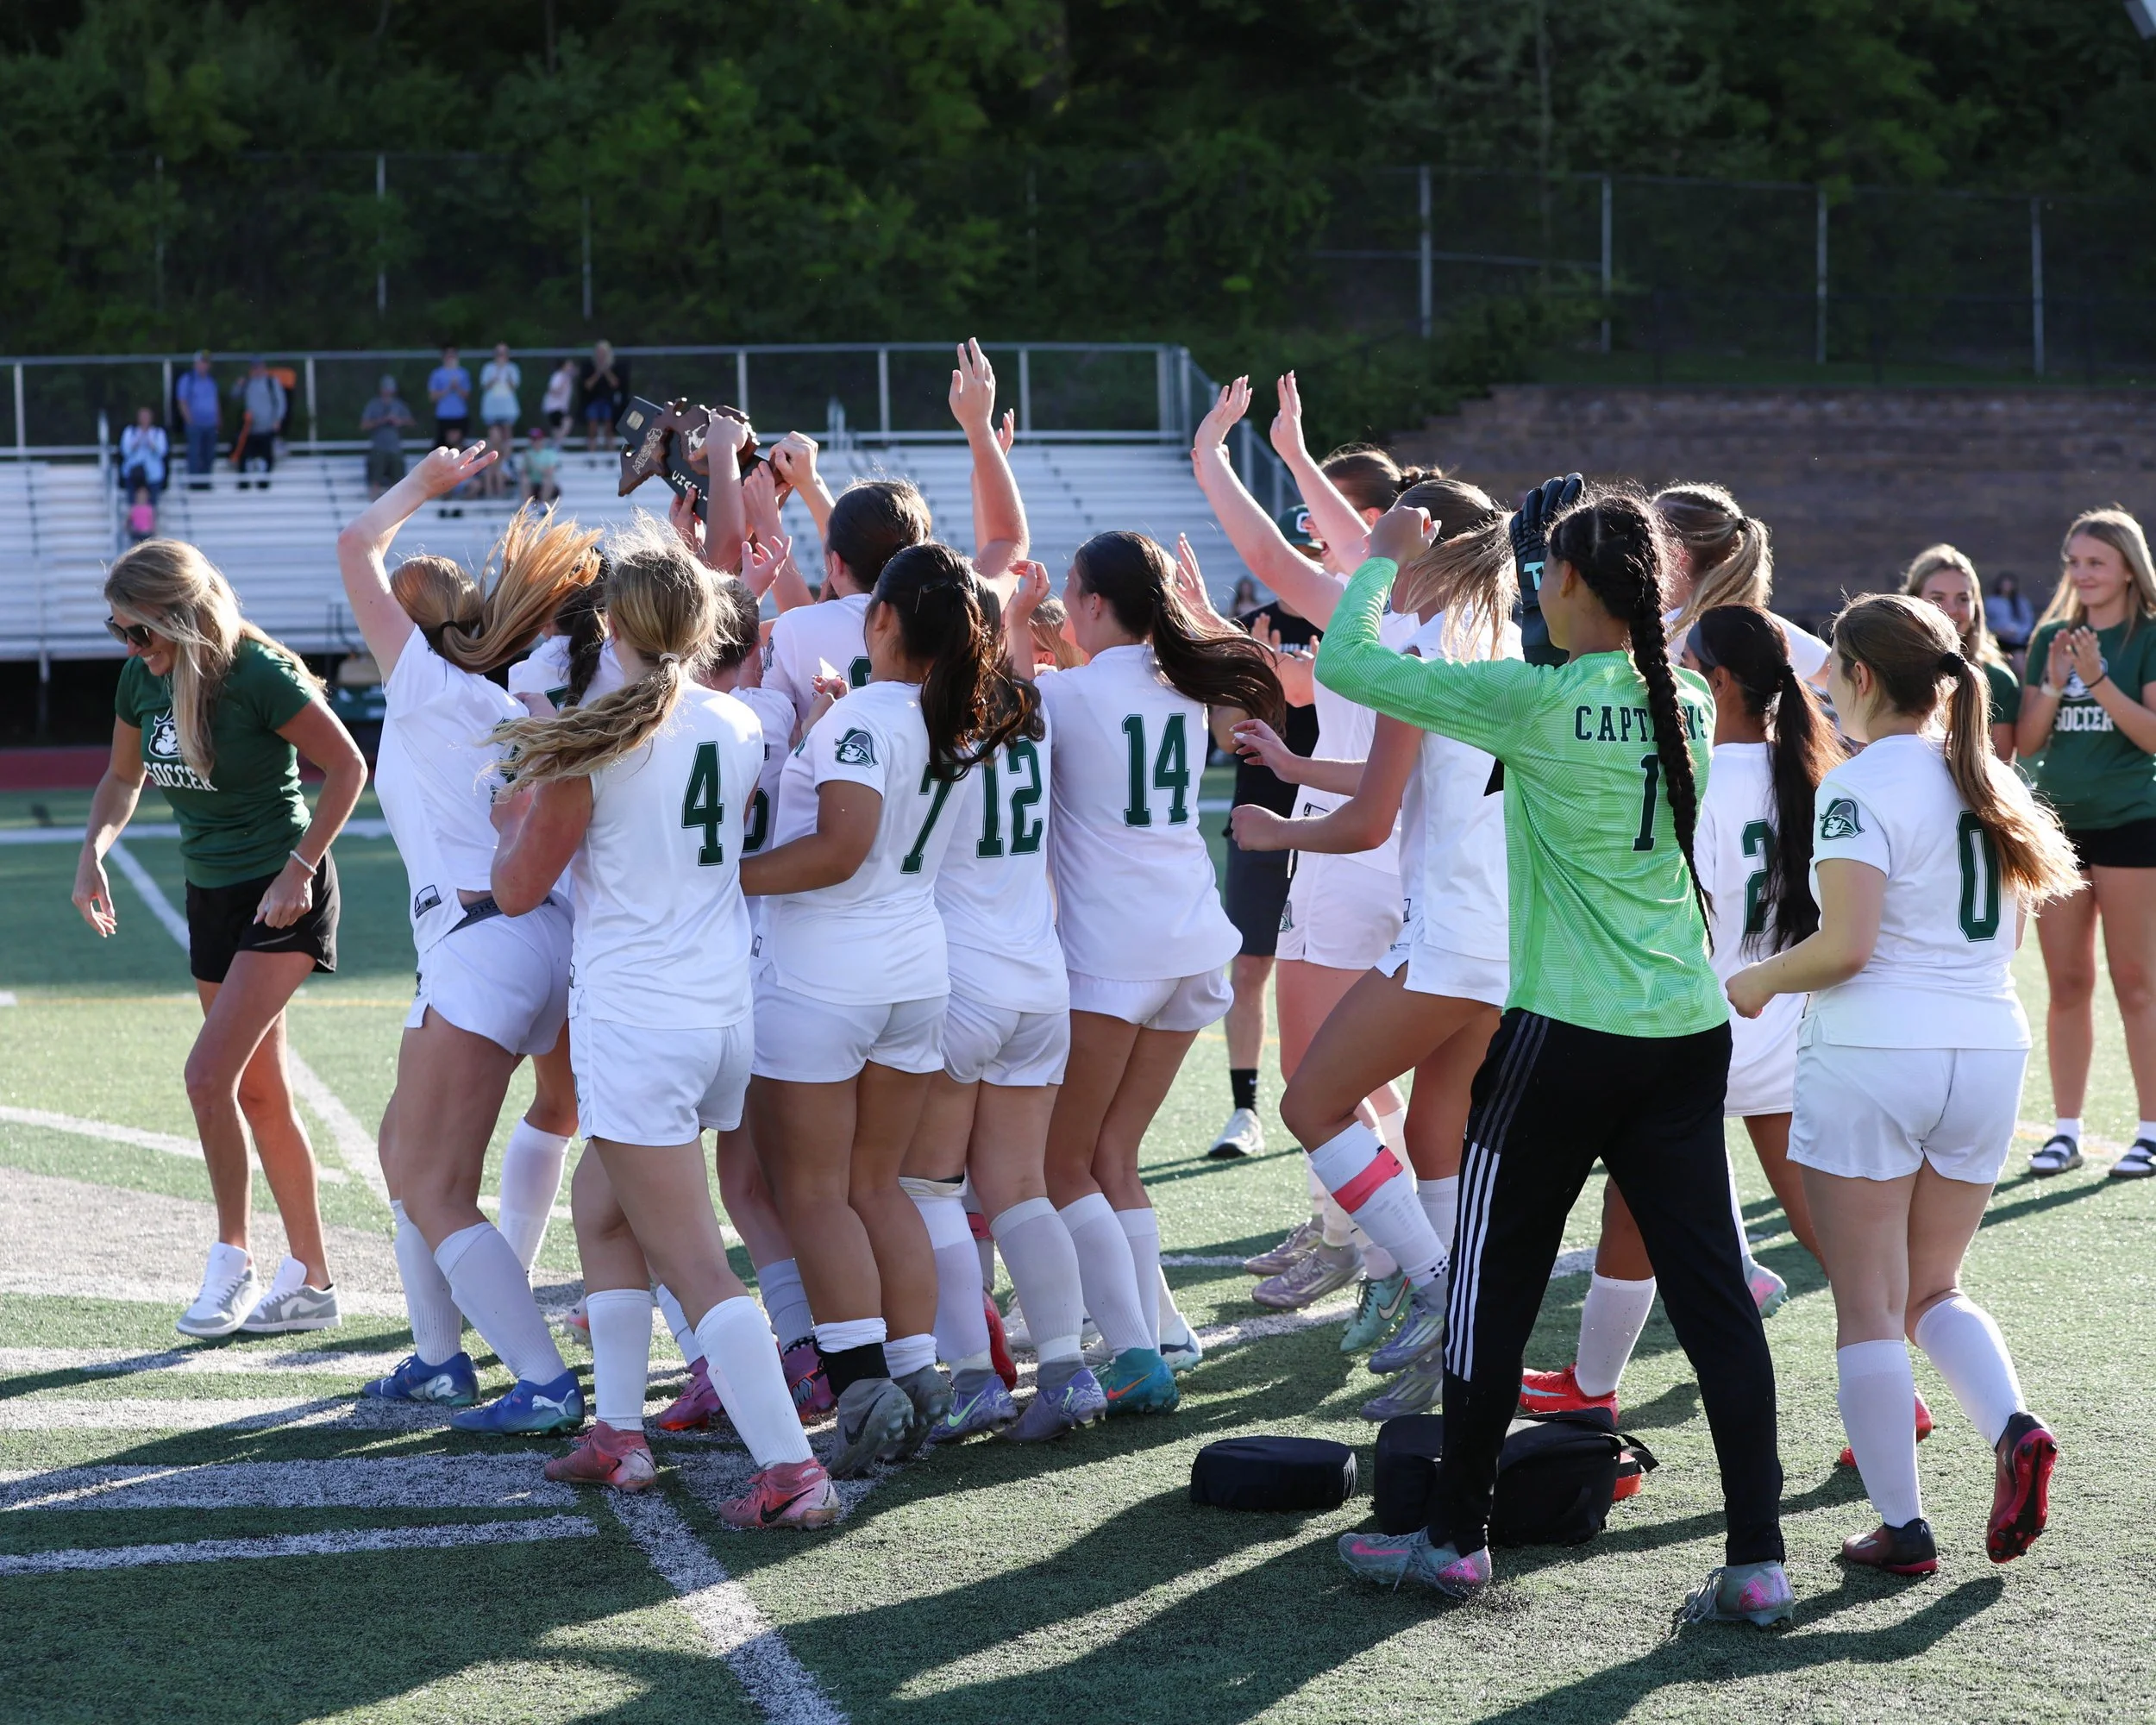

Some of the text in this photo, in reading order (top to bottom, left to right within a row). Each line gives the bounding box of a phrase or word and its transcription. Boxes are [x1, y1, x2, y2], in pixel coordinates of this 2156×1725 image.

[1122, 713, 1190, 827] 14
[1575, 705, 1708, 743] CAPTNS
[681, 741, 724, 866] 4
[900, 761, 957, 874] 7
[975, 737, 1044, 858] 12
[1632, 754, 1659, 852] 1
[1956, 811, 2002, 942] 0
